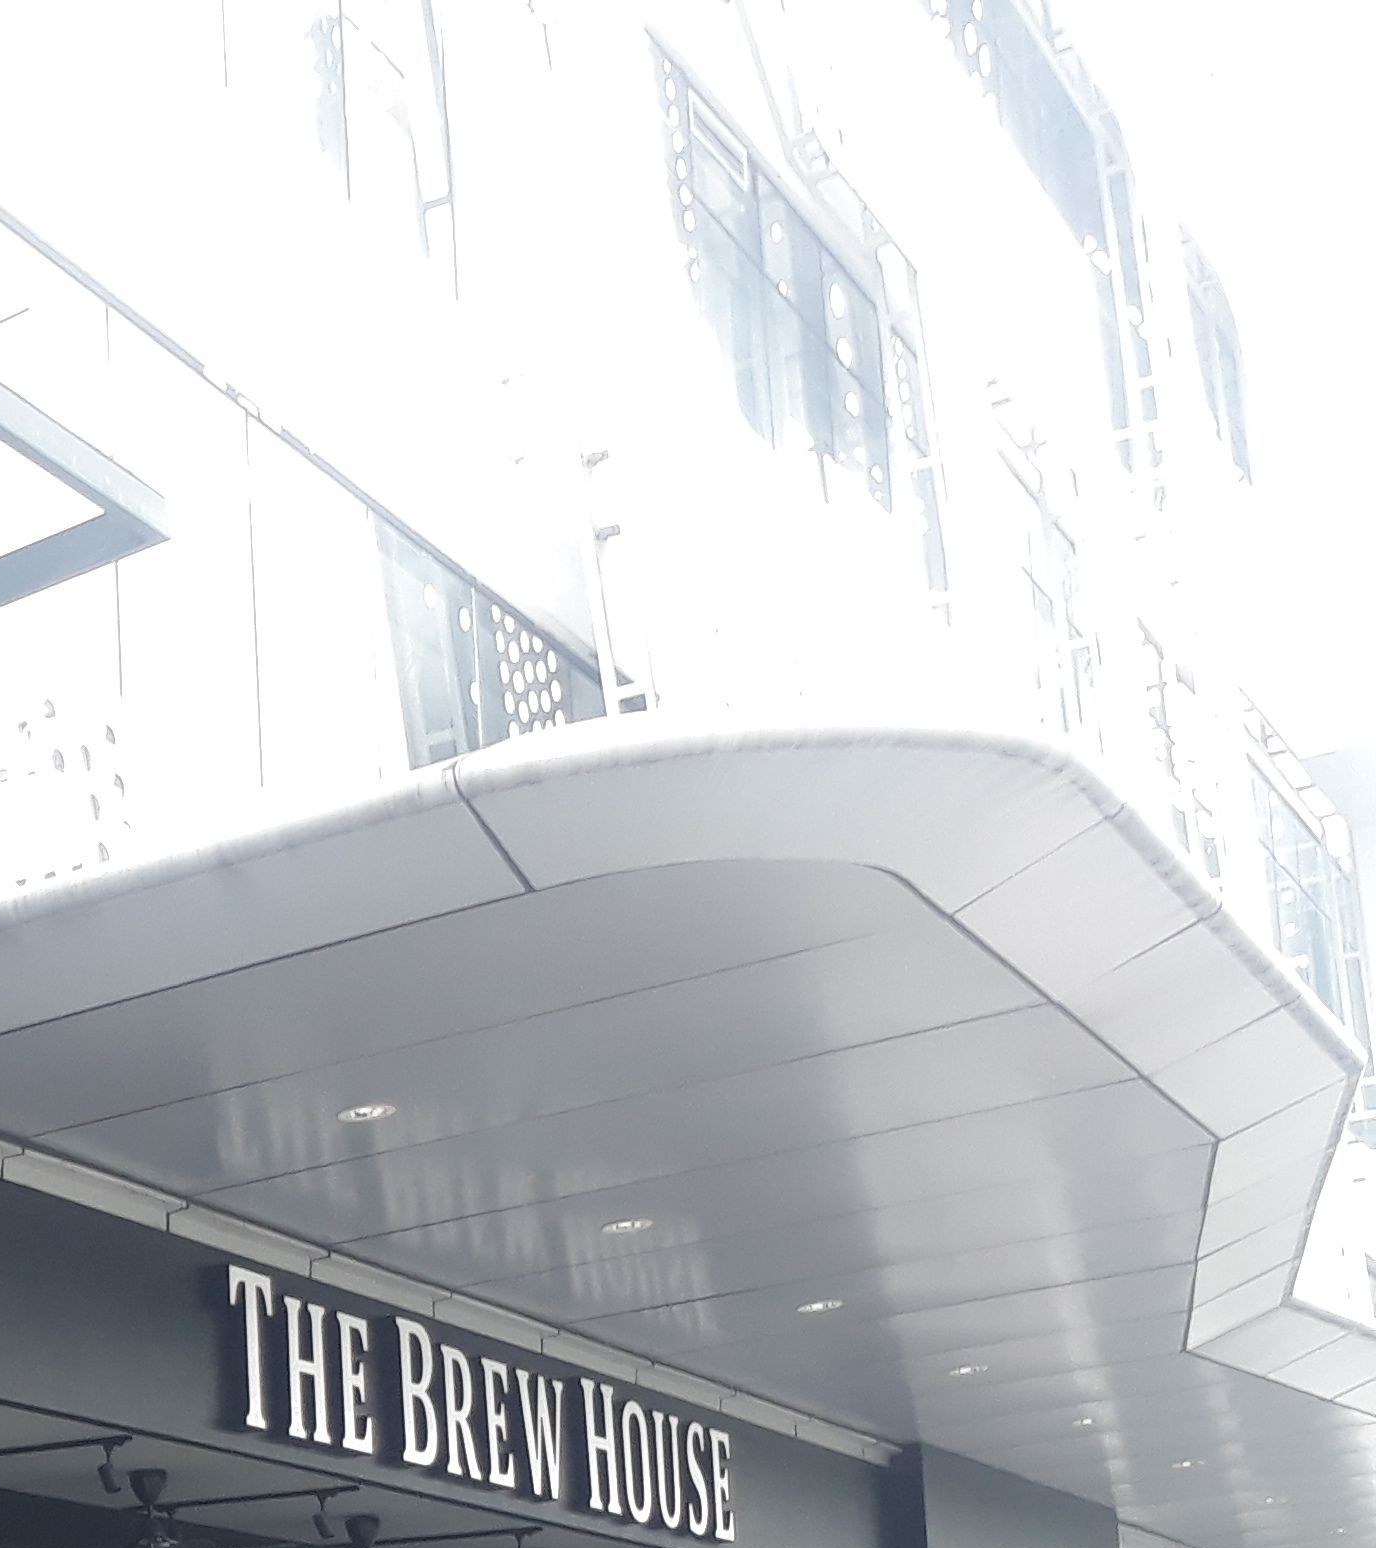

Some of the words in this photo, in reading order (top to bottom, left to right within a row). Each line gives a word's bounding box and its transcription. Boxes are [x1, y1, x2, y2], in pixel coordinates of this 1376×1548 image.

[228, 1264, 374, 1454] THE
[395, 1315, 565, 1499] BREW
[580, 1376, 736, 1542] HOUSE
